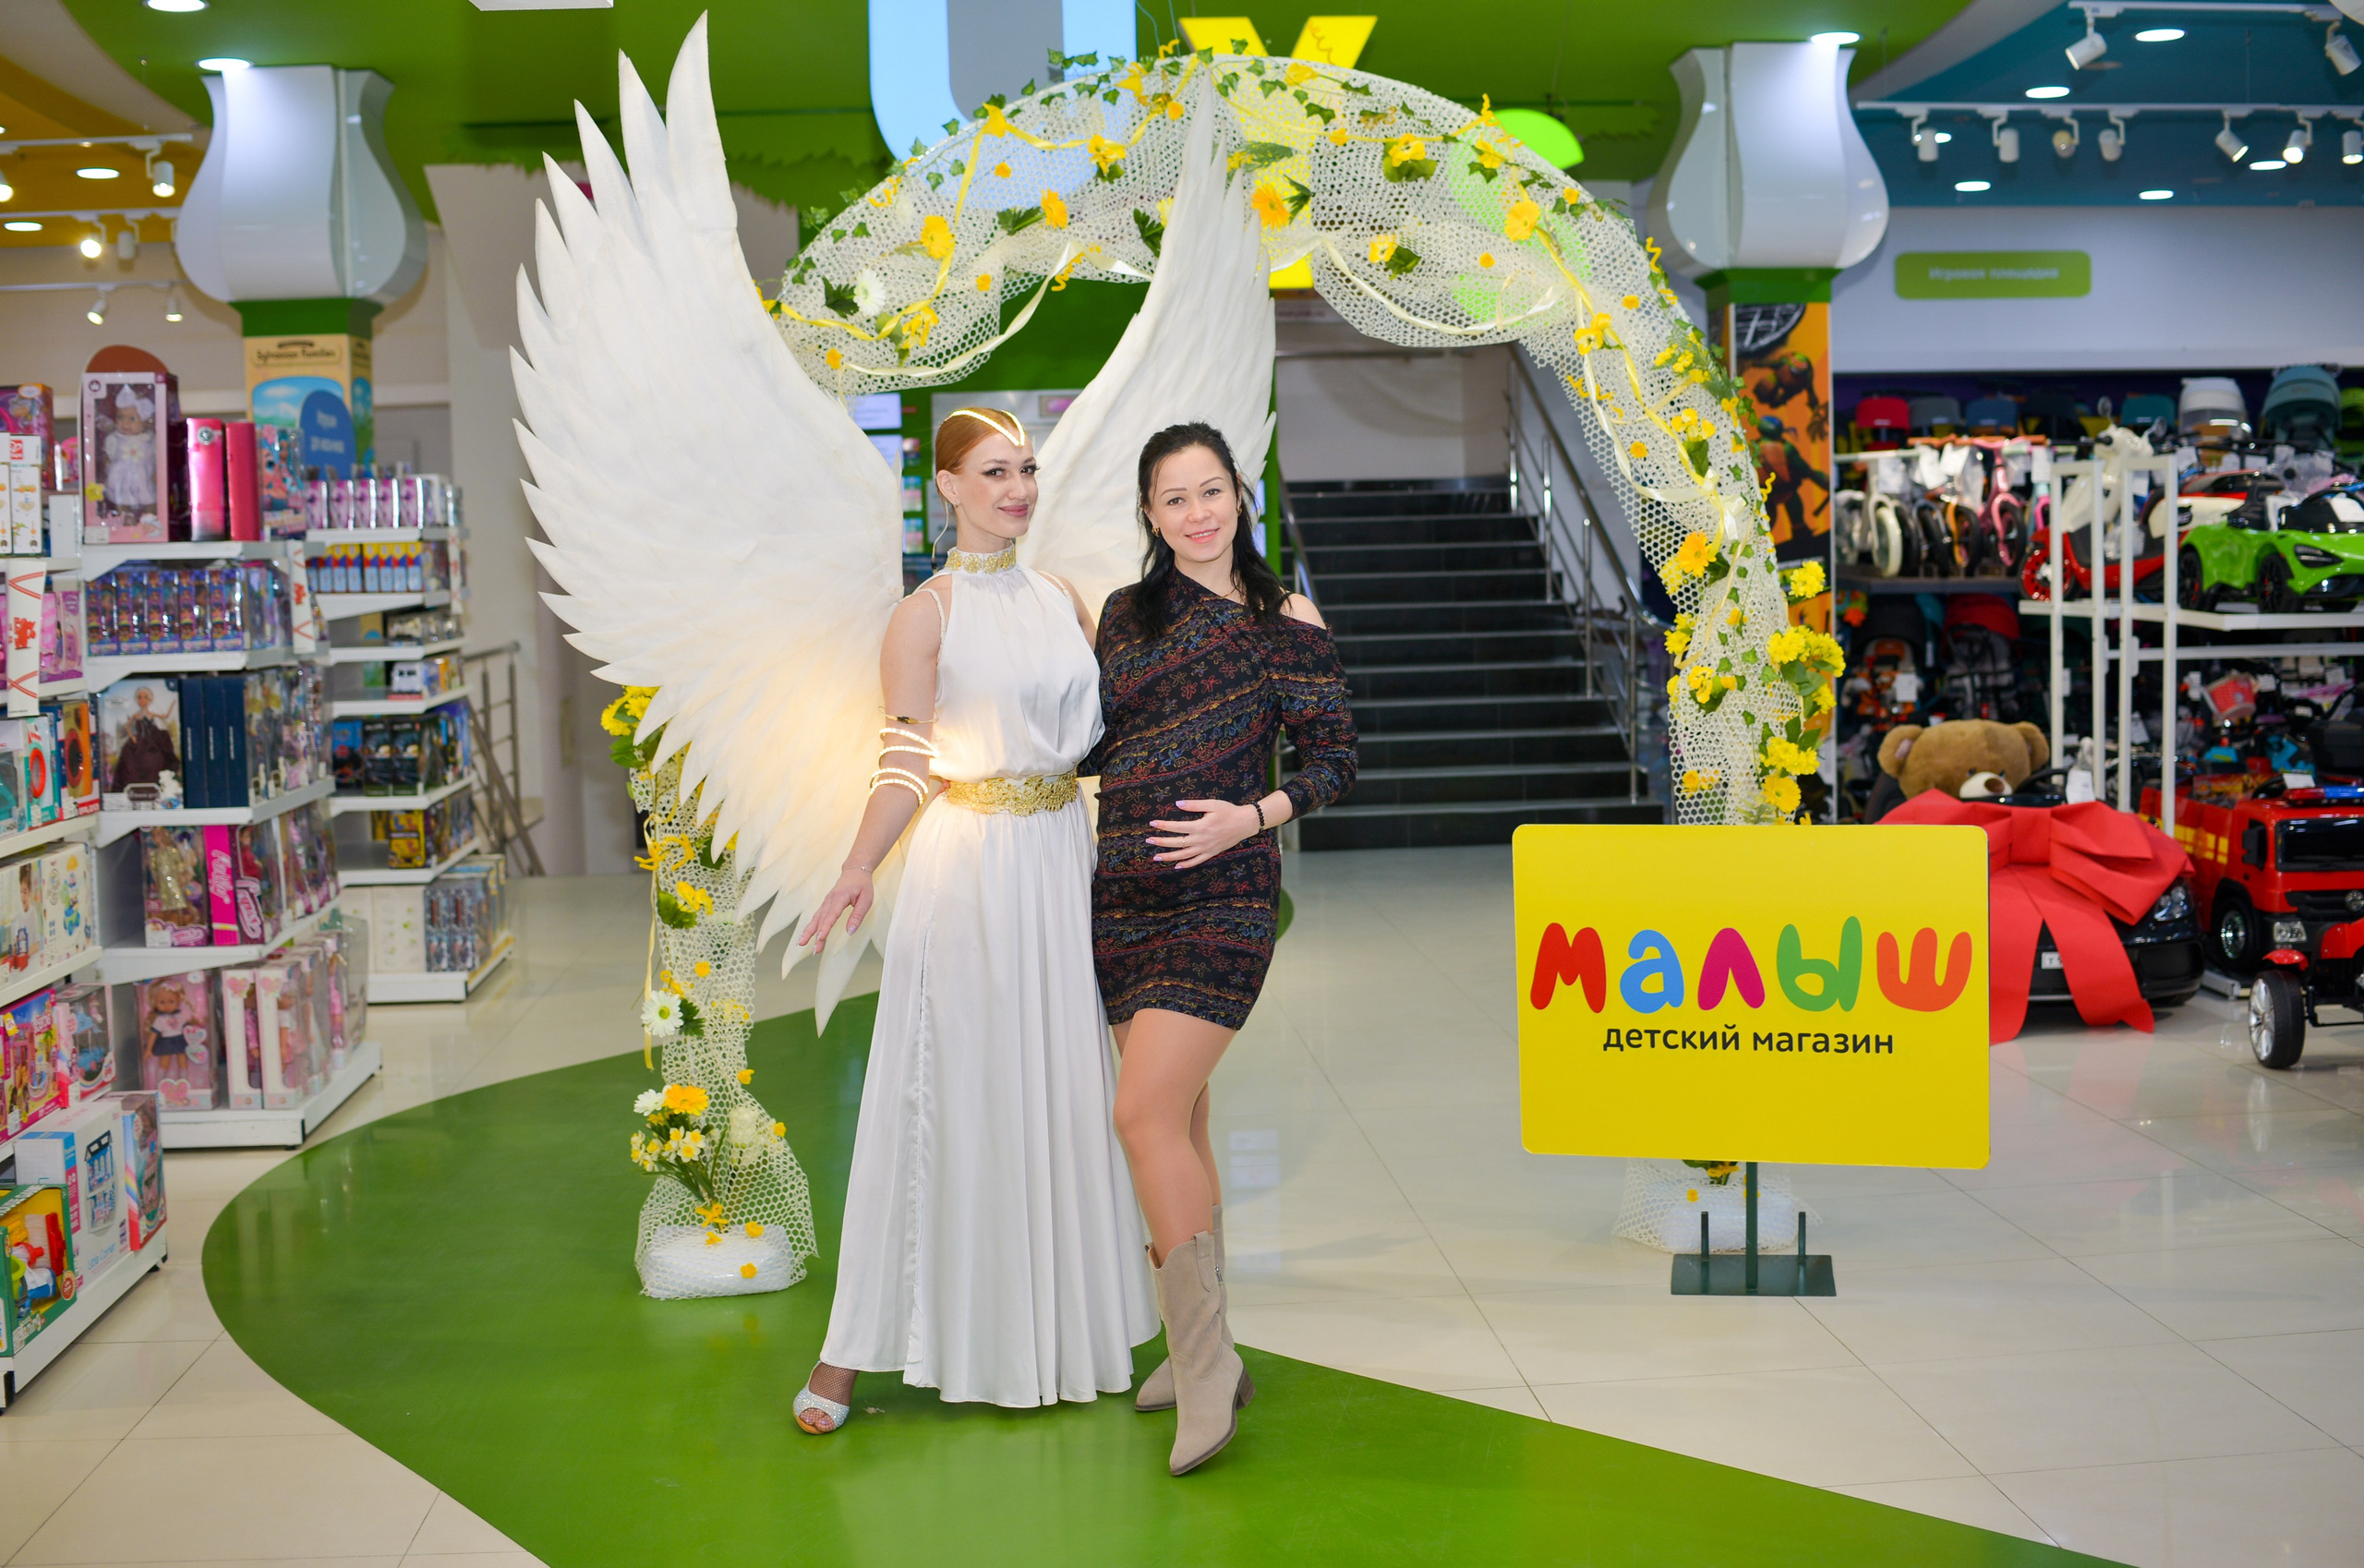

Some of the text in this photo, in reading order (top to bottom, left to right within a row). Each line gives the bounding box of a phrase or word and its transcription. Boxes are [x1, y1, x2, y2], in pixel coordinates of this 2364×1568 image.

[1529, 915, 1973, 1015] малыш
[1603, 1024, 1894, 1055] детский магазин
